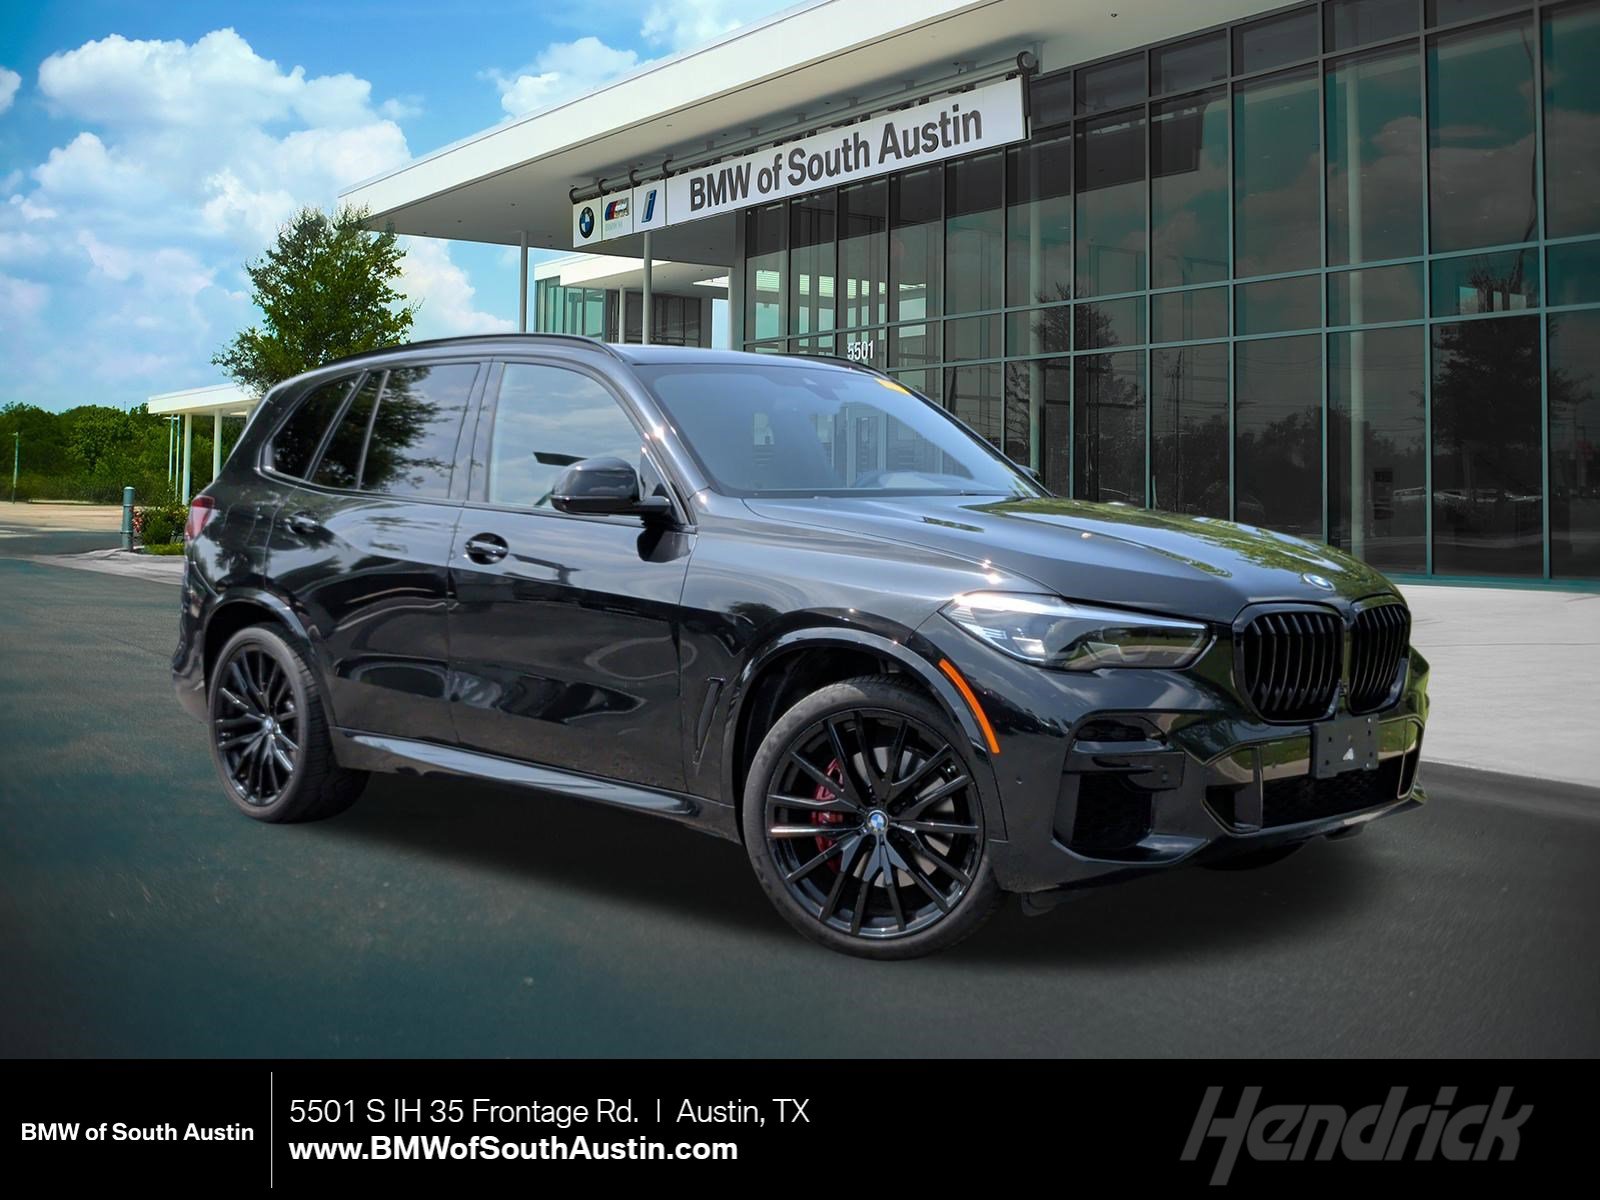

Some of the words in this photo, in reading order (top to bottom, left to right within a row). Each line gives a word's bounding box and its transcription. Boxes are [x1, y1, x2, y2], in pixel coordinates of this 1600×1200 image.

[690, 162, 751, 212] BMW
[757, 153, 783, 194] of
[788, 132, 870, 187] South
[878, 104, 983, 165] Austin
[847, 340, 874, 360] 5501
